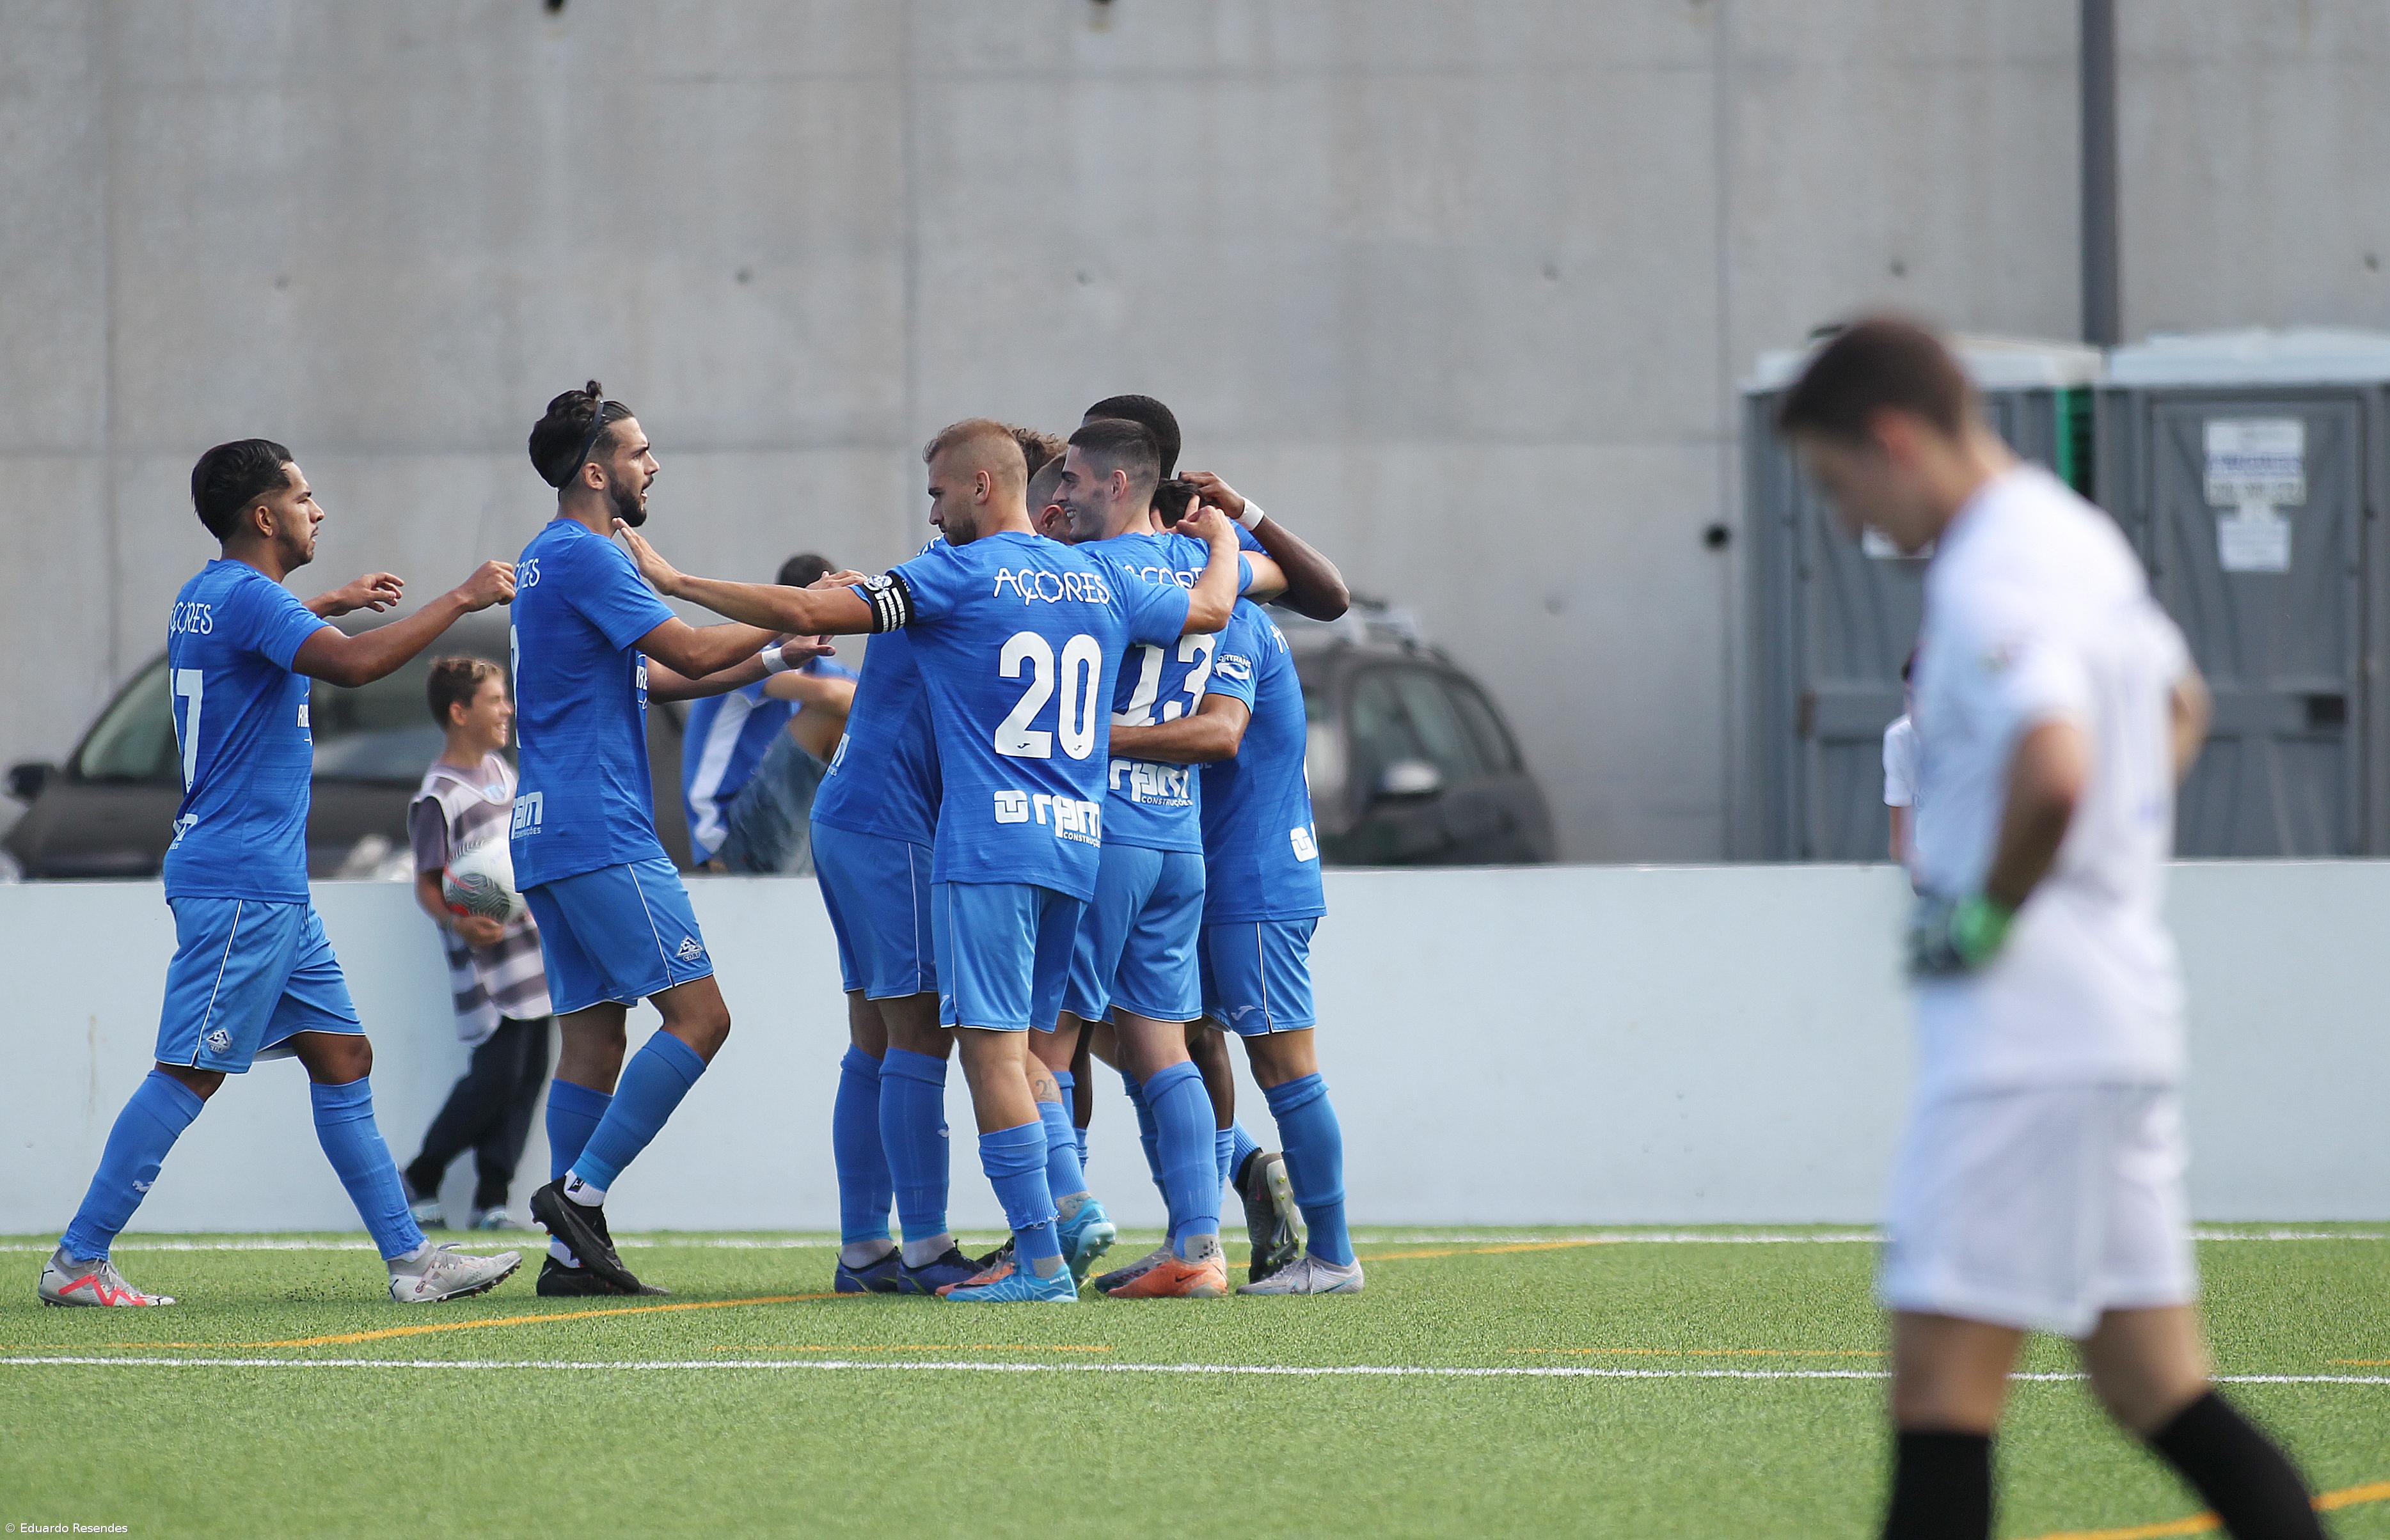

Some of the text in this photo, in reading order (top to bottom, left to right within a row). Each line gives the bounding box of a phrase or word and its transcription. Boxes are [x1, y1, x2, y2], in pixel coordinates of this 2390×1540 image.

[993, 567, 1111, 606] AÇORES
[994, 631, 1102, 760] 20
[1111, 633, 1215, 727] 13
